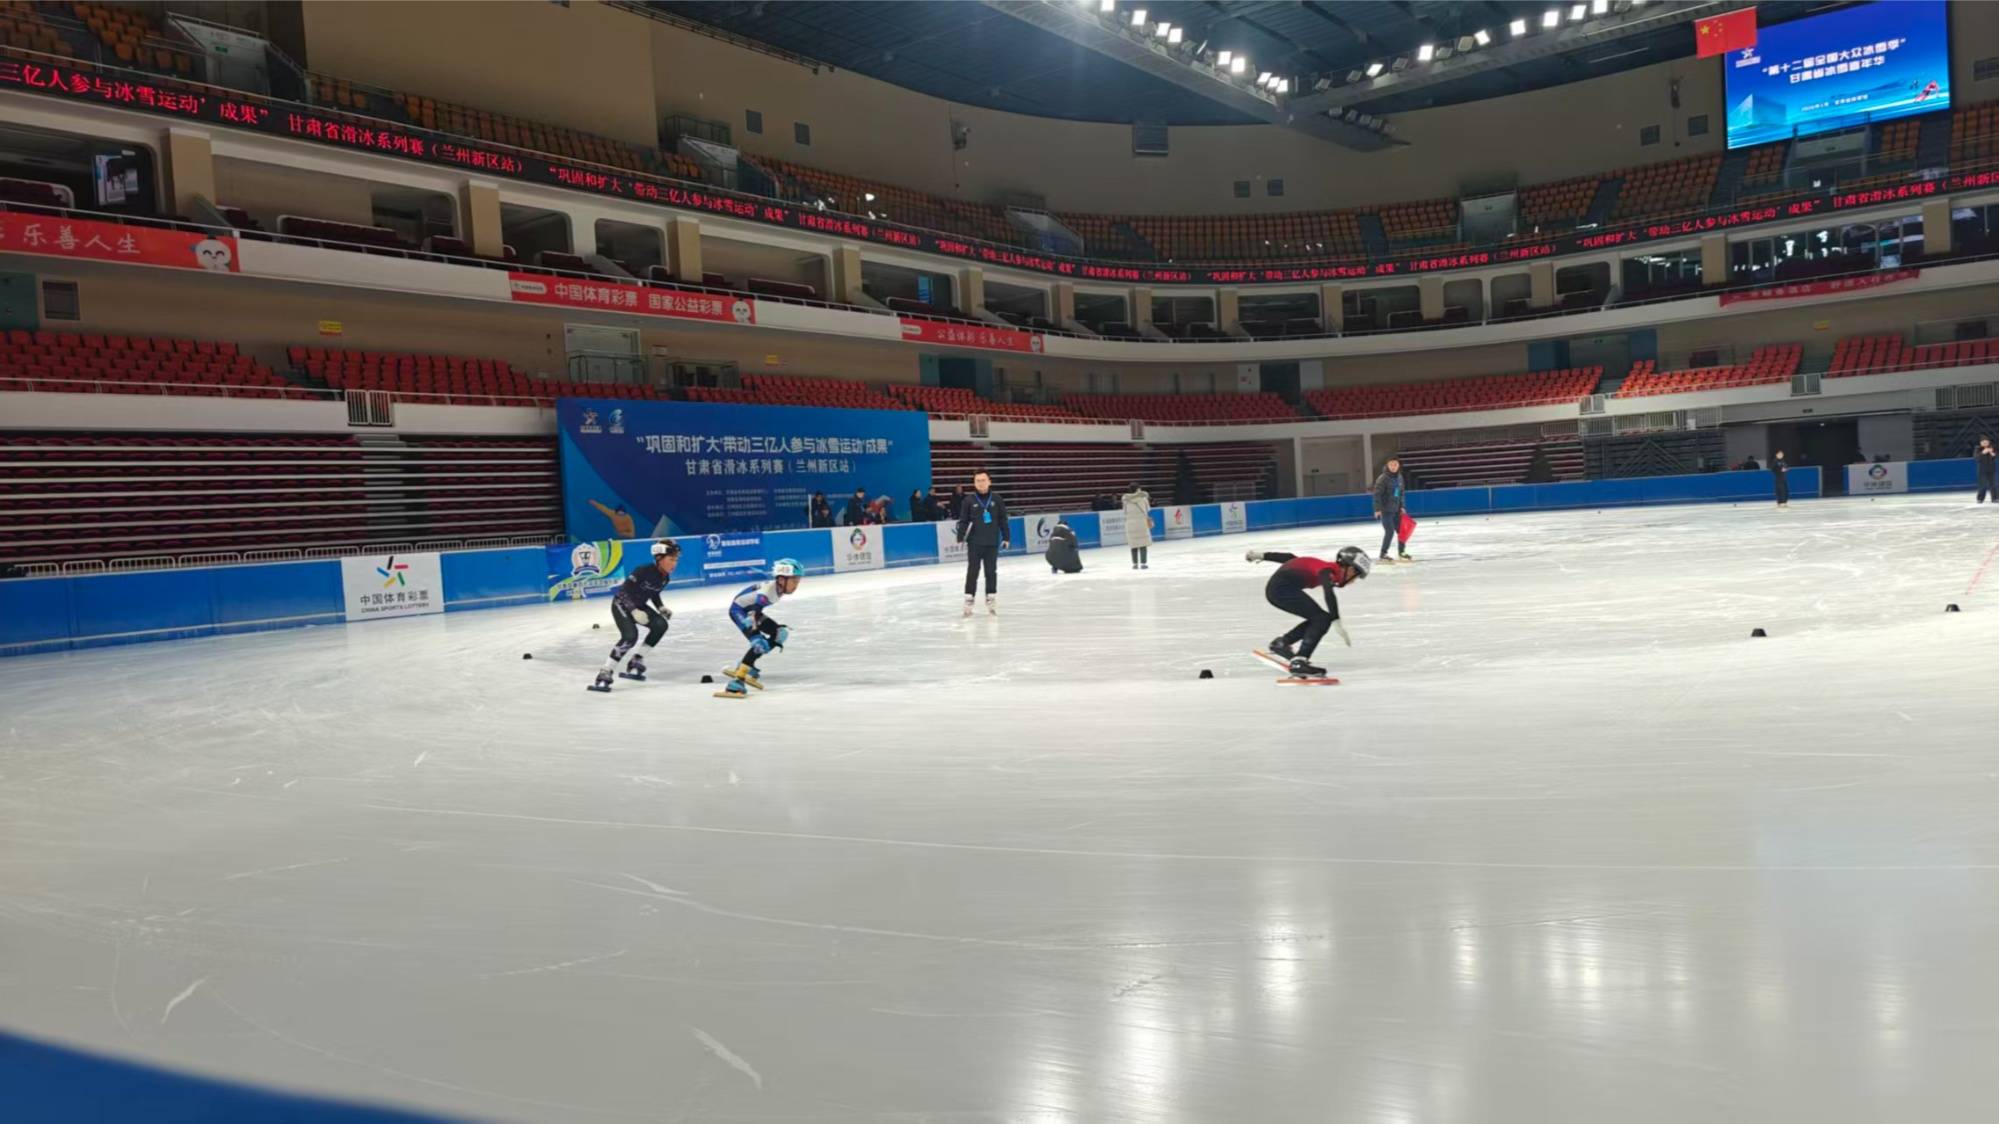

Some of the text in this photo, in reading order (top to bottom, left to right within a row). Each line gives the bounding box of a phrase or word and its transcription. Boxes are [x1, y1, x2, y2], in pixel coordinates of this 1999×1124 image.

[23, 223, 141, 254] 乐善人生
[554, 283, 638, 307] 中国体育彩票
[648, 293, 723, 316] 国家公益彩票
[685, 458, 857, 477] 甘肃省滑冰系列赛（兰州新区站）
[360, 590, 429, 606] 中国体育彩票
[381, 604, 403, 612] SPORTS
